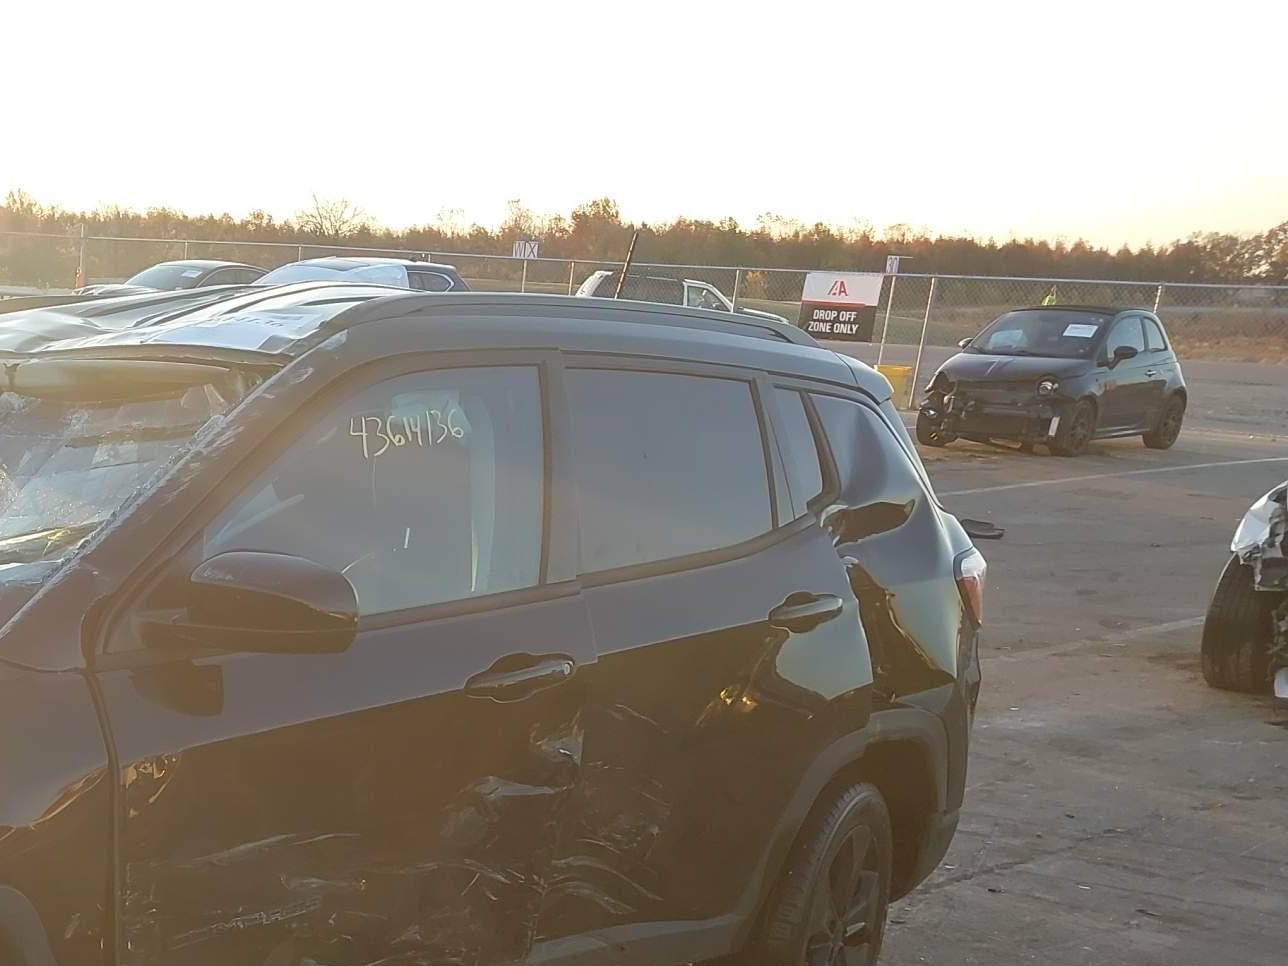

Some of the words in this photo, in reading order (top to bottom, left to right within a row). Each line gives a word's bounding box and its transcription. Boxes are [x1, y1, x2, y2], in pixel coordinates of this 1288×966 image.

[813, 309, 838, 320] DROP
[839, 311, 857, 322] OFF
[808, 321, 832, 333] ZONE
[833, 323, 859, 334] ONLY
[349, 407, 465, 459] 43614136
